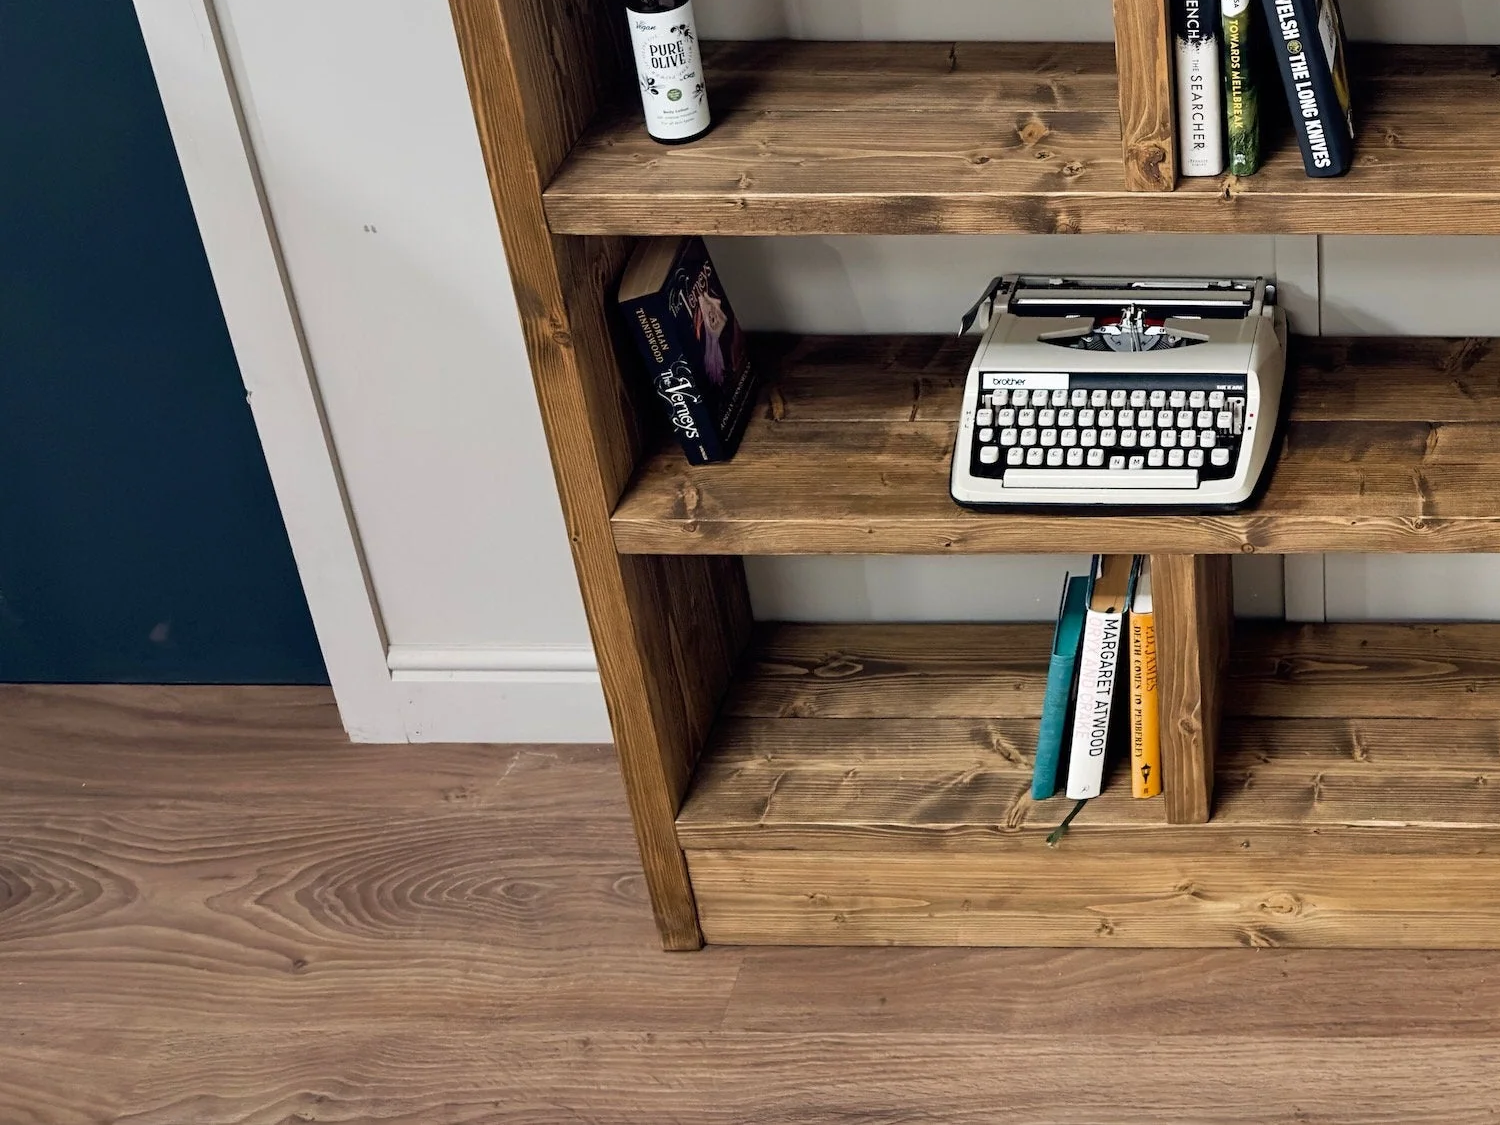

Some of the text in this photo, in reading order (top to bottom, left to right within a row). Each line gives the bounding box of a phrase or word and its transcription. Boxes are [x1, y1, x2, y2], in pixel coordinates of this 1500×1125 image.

[649, 40, 684, 56] PURE
[651, 52, 686, 68] OLIVE
[1192, 59, 1200, 72] THE
[1289, 52, 1310, 80] THE
[1228, 19, 1243, 129] TOWARDS MELLBREAK
[1190, 75, 1205, 150] SEARCHER
[1295, 81, 1319, 118] LONG
[1304, 119, 1331, 169] KNIVES
[636, 308, 664, 363] TINNISWOOD
[650, 317, 669, 350] ADRIAN
[661, 369, 699, 439] The Verneys
[992, 378, 1026, 387] brother
[1075, 617, 1102, 739] ORYX AND CRAKE
[1089, 619, 1119, 757] MARGARET ATWOOD
[1133, 626, 1143, 757] DEATH COMES TO PEMBERLEY
[1145, 649, 1158, 692] JAMES
